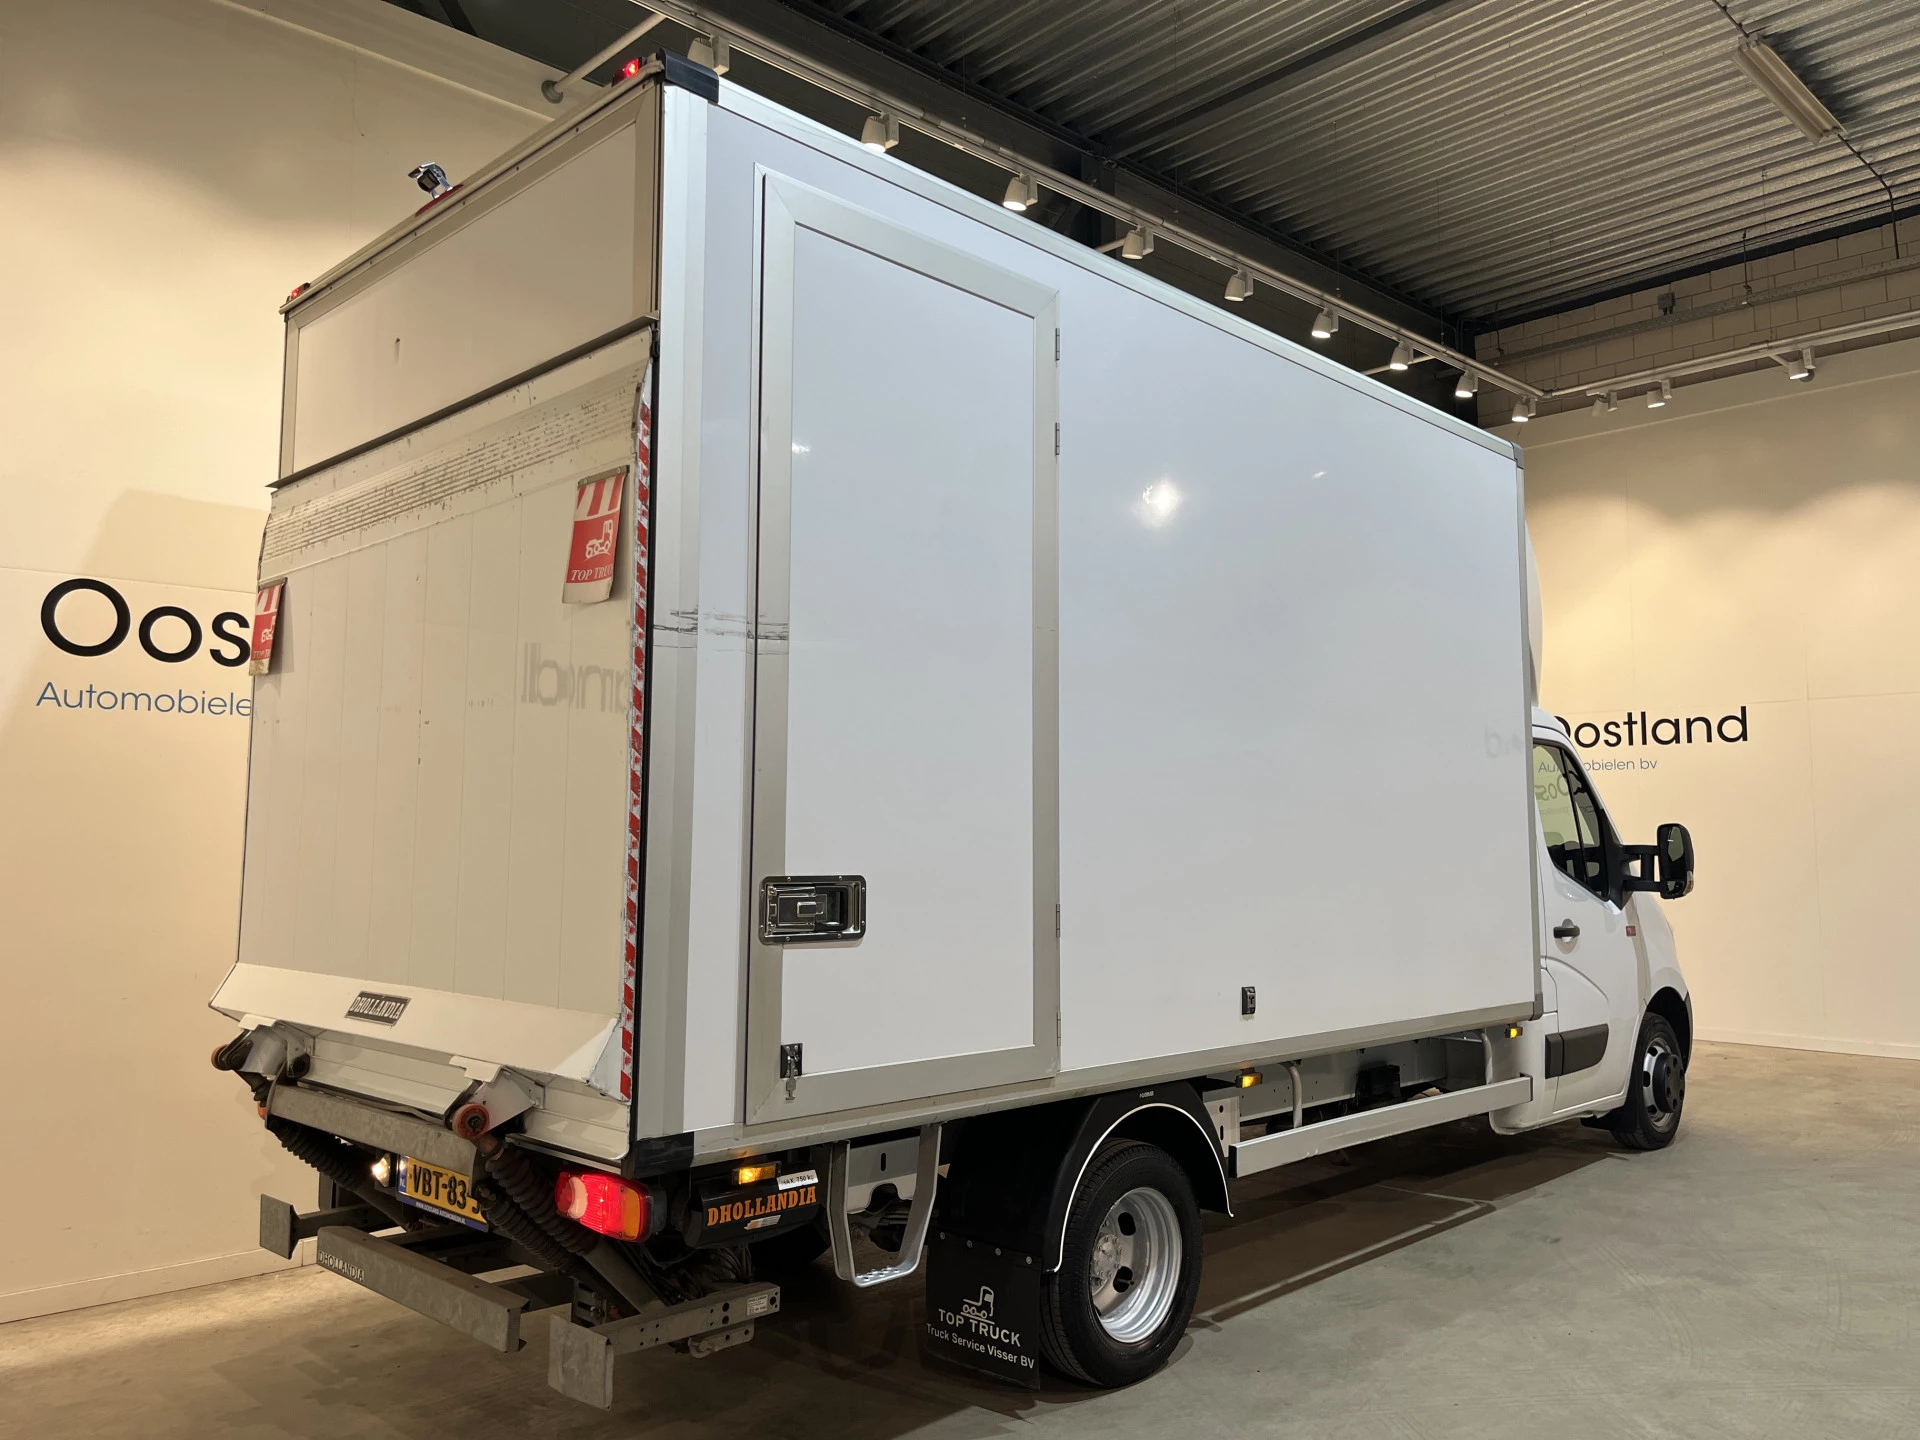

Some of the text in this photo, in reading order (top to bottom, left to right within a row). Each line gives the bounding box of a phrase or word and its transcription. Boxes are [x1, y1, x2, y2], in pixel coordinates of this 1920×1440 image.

[571, 569, 592, 581] TOP
[1640, 758, 1657, 770] bv
[349, 996, 405, 1019] DHOLLANDIA
[796, 1174, 807, 1183] 750
[707, 1186, 817, 1226] DHOLLANDIA
[319, 1250, 365, 1281] DHOLLANDIA
[939, 1308, 1020, 1347] TOP TRUCK
[927, 1323, 1035, 1369] Truck Service Visser BV
